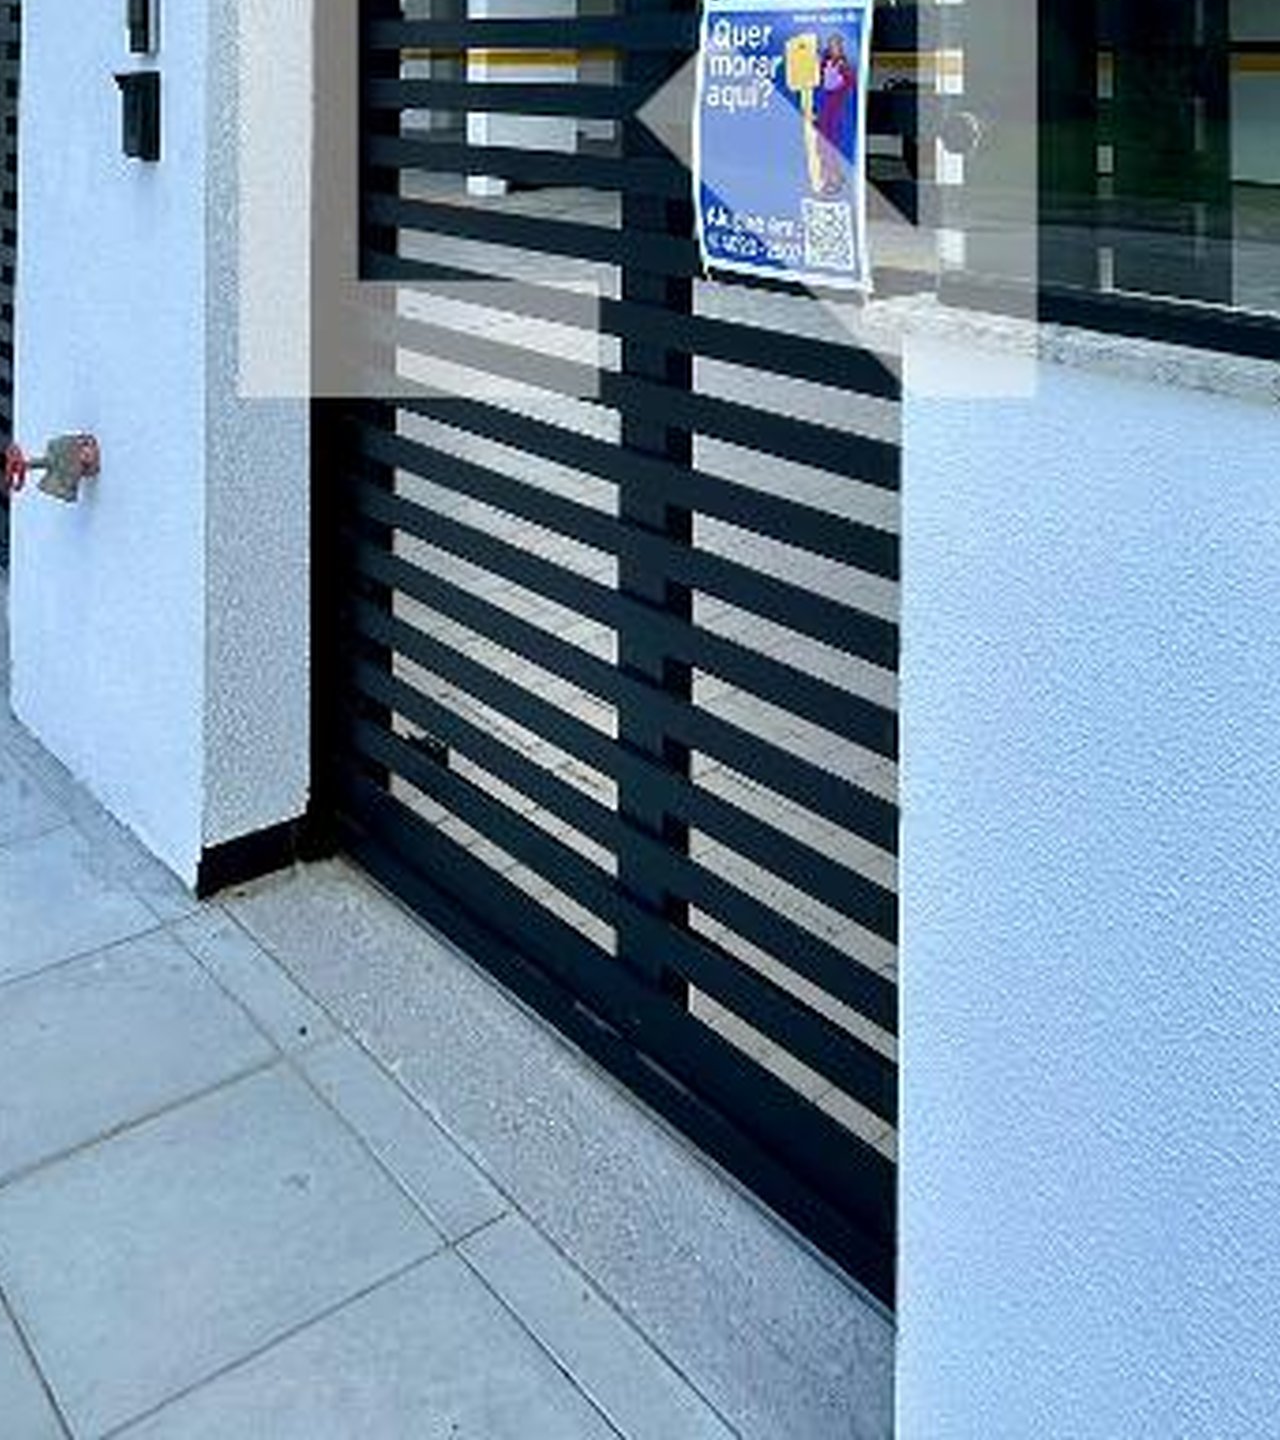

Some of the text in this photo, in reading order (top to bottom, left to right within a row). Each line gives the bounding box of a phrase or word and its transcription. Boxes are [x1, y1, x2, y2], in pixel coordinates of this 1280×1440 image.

[713, 17, 773, 48] Quer
[709, 54, 783, 79] morar
[706, 78, 775, 113] aqui?
